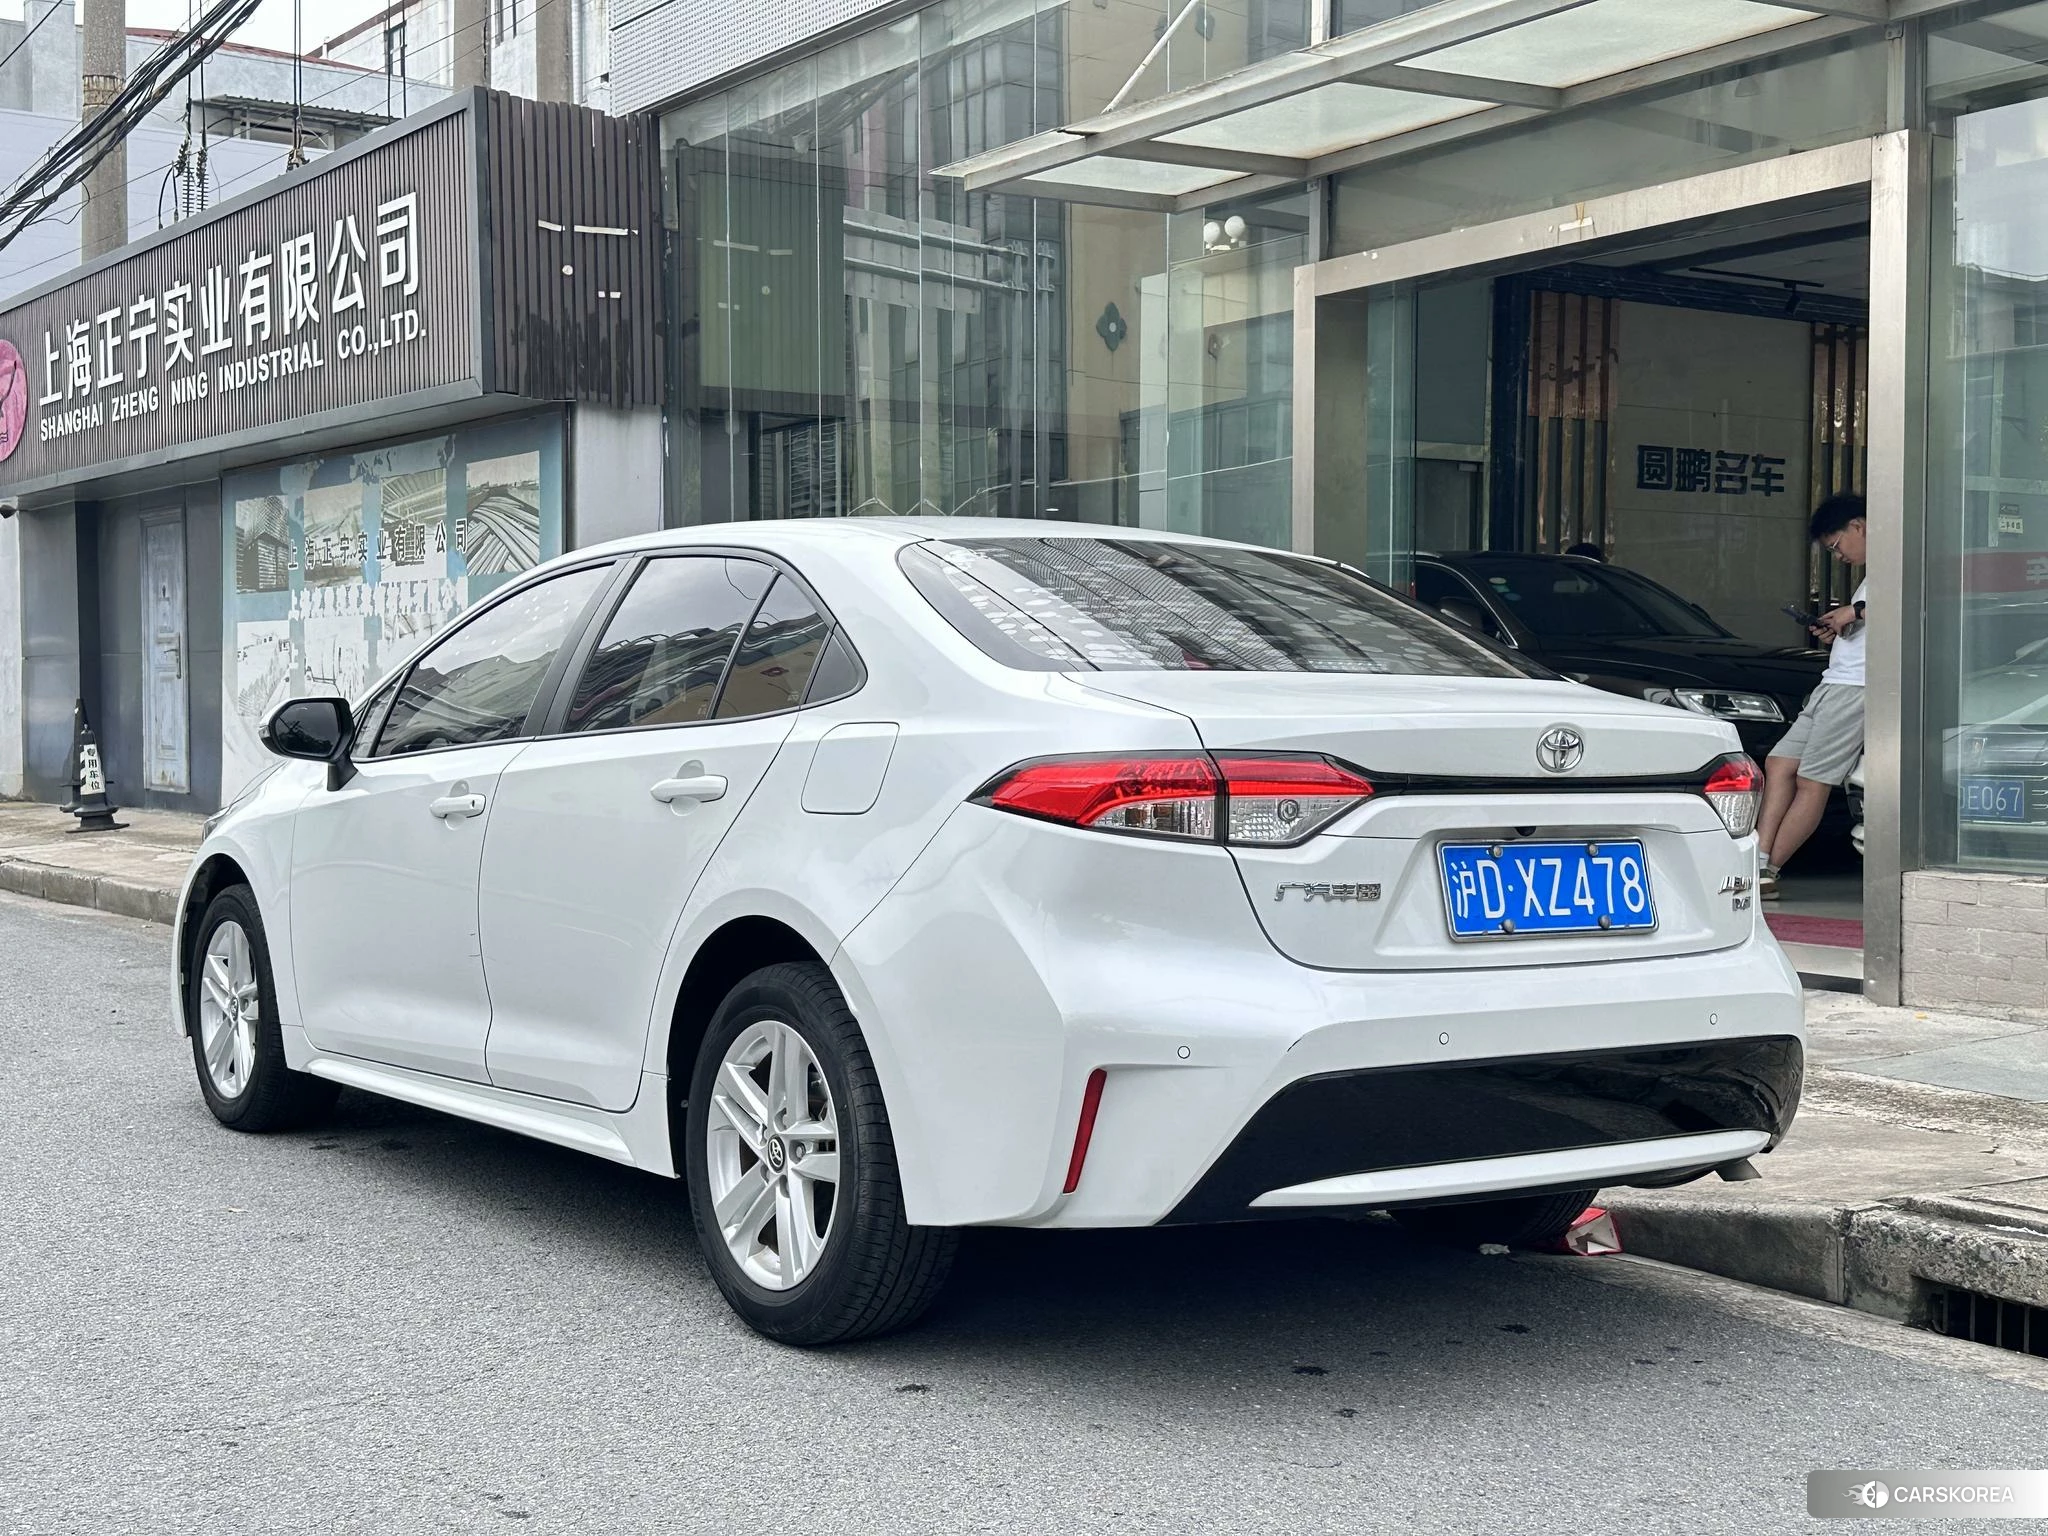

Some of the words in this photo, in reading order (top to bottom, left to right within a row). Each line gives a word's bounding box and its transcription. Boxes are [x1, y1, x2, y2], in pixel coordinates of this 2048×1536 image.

[39, 192, 418, 406] 上海正宁实业有限公司
[41, 402, 103, 441] SHANGHAI
[112, 386, 159, 422] ZHENG
[171, 371, 209, 406] NING
[219, 338, 324, 393] INDUSTRIAL
[1636, 444, 1786, 497] 圆鹏名车
